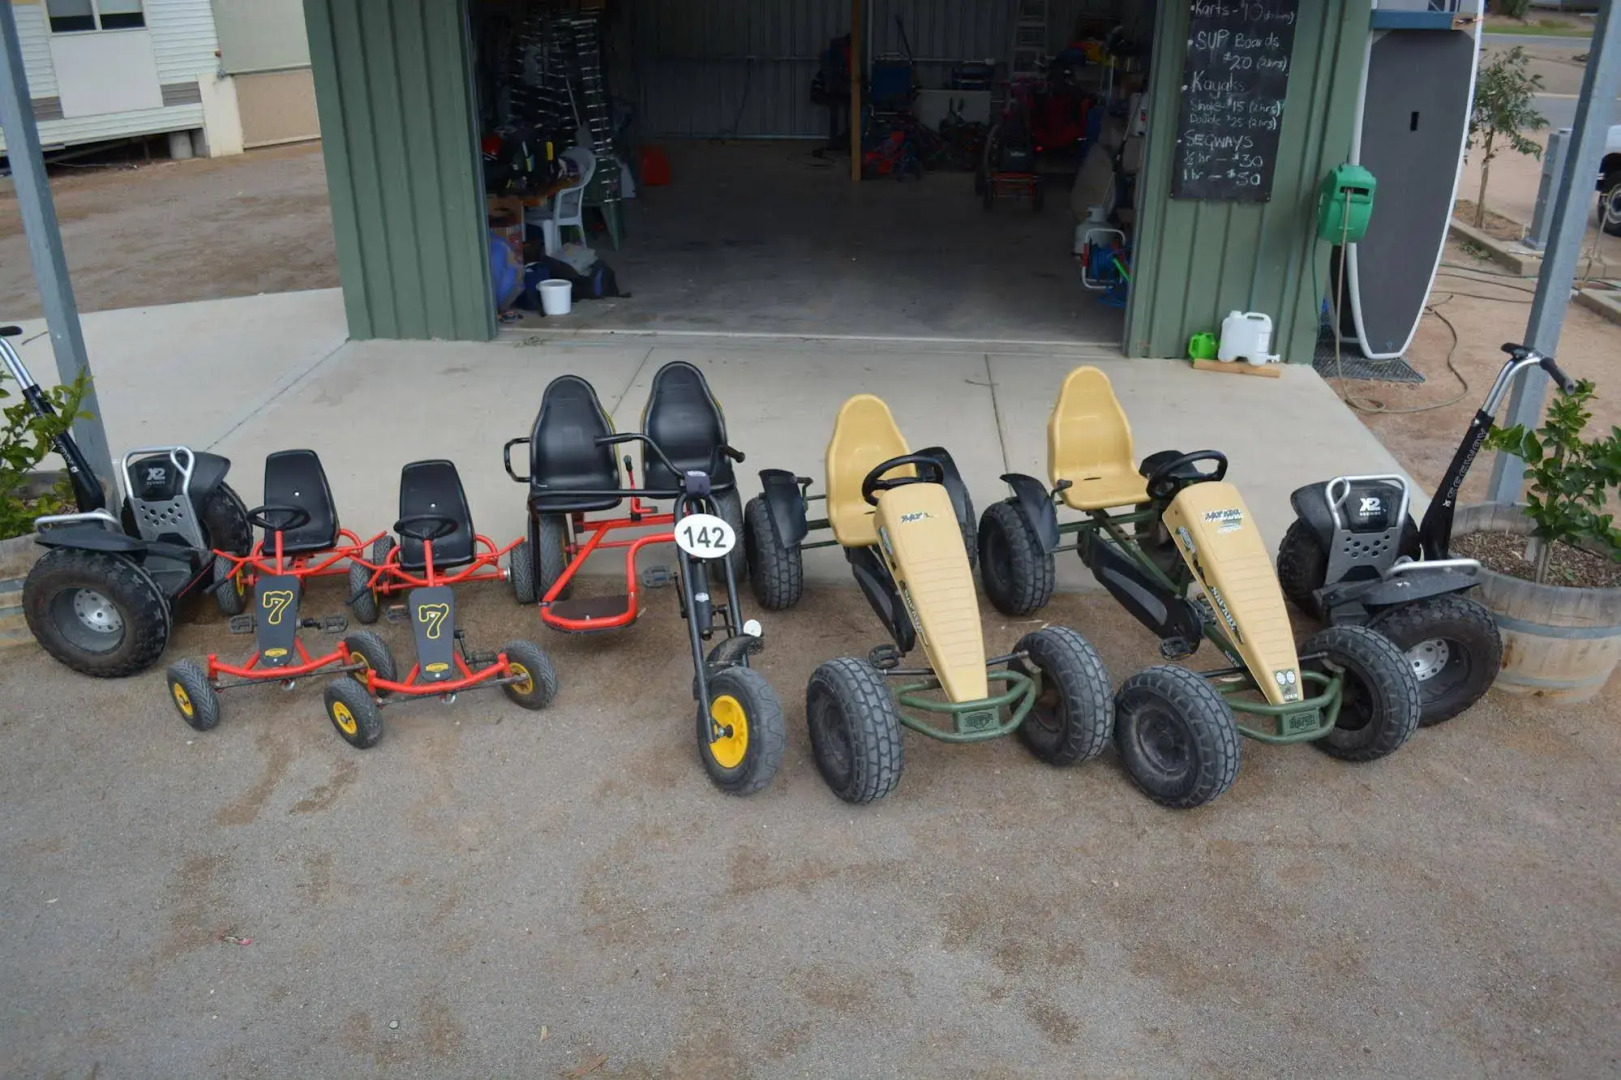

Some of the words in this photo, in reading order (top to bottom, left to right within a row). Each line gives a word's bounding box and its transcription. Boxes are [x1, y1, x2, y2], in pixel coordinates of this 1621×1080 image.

[1195, 0, 1230, 16] Karts
[1197, 29, 1230, 50] SUP
[1234, 31, 1280, 49] Boards
[1223, 52, 1253, 70] $20
[1191, 70, 1246, 99] Kayaks
[1184, 129, 1254, 152] SEGWAYS
[1198, 153, 1211, 163] hr
[1231, 152, 1264, 168] $30
[1227, 168, 1261, 186] $50
[146, 467, 166, 481] X2
[1359, 497, 1381, 512] X2
[683, 526, 727, 549] 142
[263, 590, 294, 625] 7
[418, 602, 450, 639] 7
